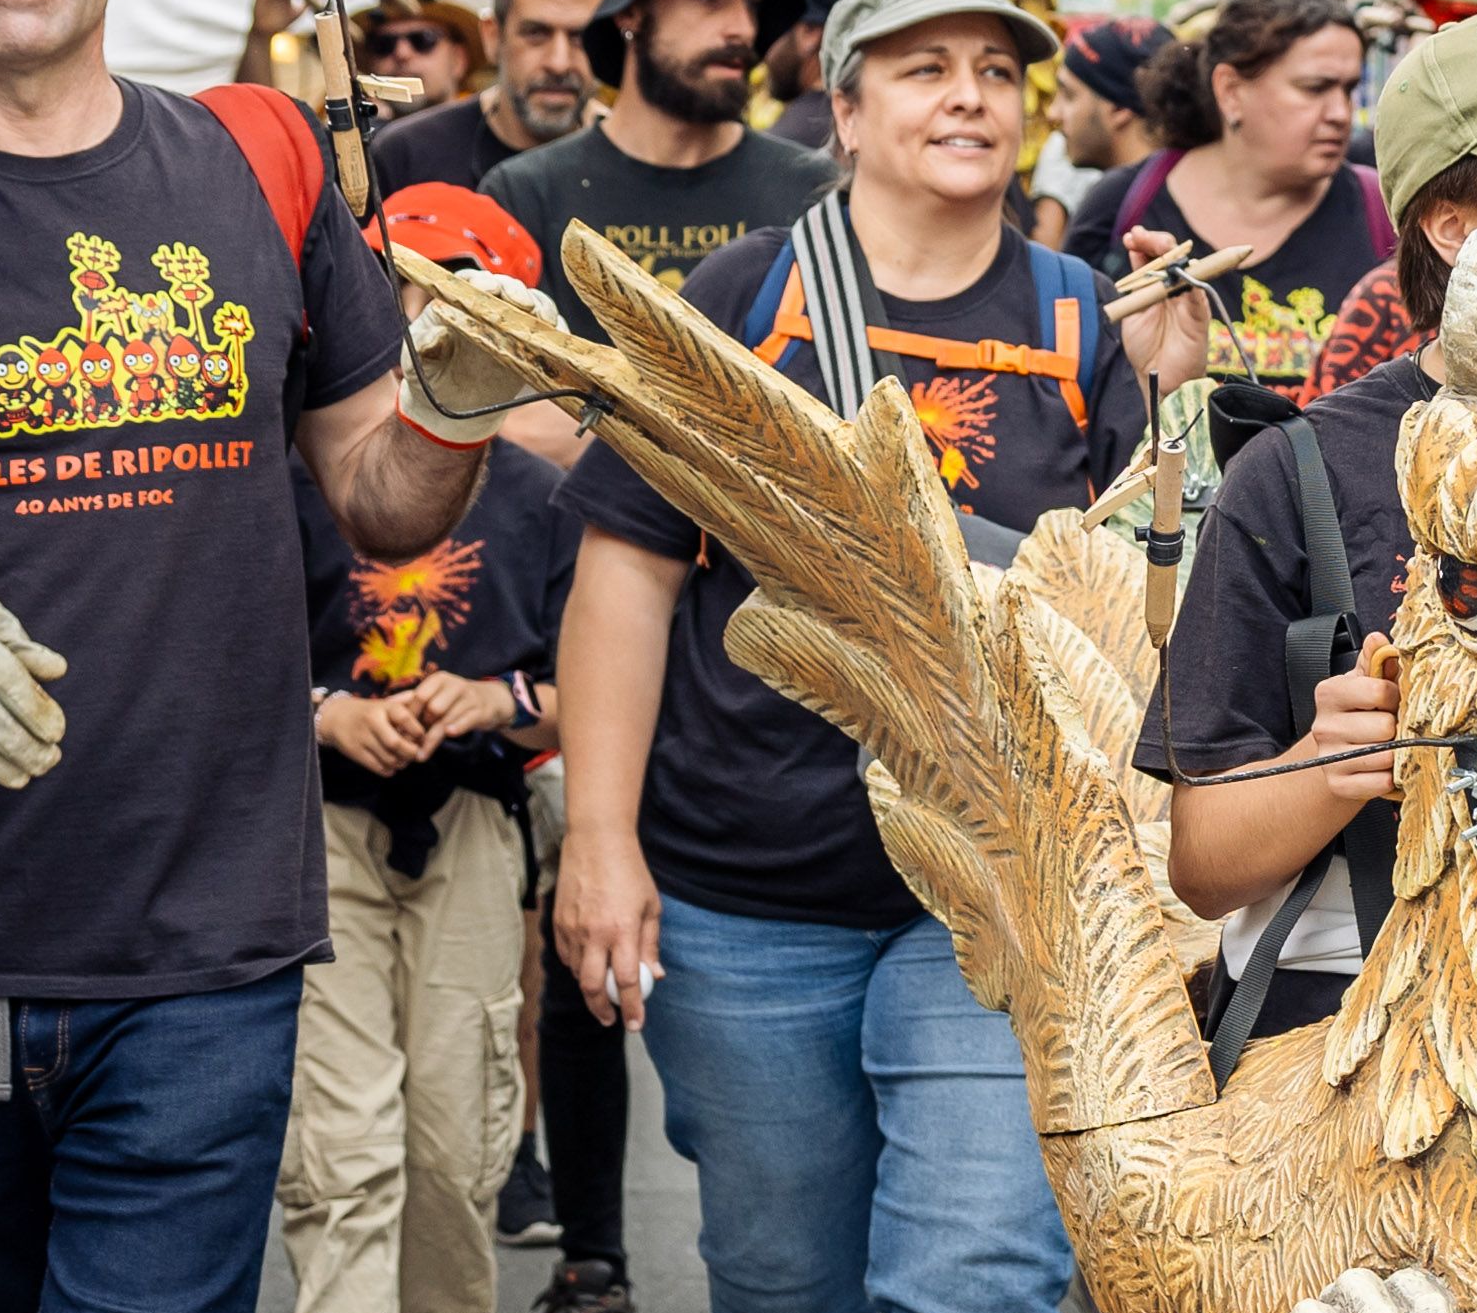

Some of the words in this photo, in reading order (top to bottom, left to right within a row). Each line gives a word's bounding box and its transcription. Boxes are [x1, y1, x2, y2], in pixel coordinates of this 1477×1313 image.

[604, 224, 670, 249] POLL
[56, 451, 102, 480] DE
[111, 440, 255, 477] RIPOLLET
[14, 499, 44, 516] 40
[47, 494, 104, 514] ANYS
[108, 492, 133, 508] DE
[138, 489, 174, 506] FOC
